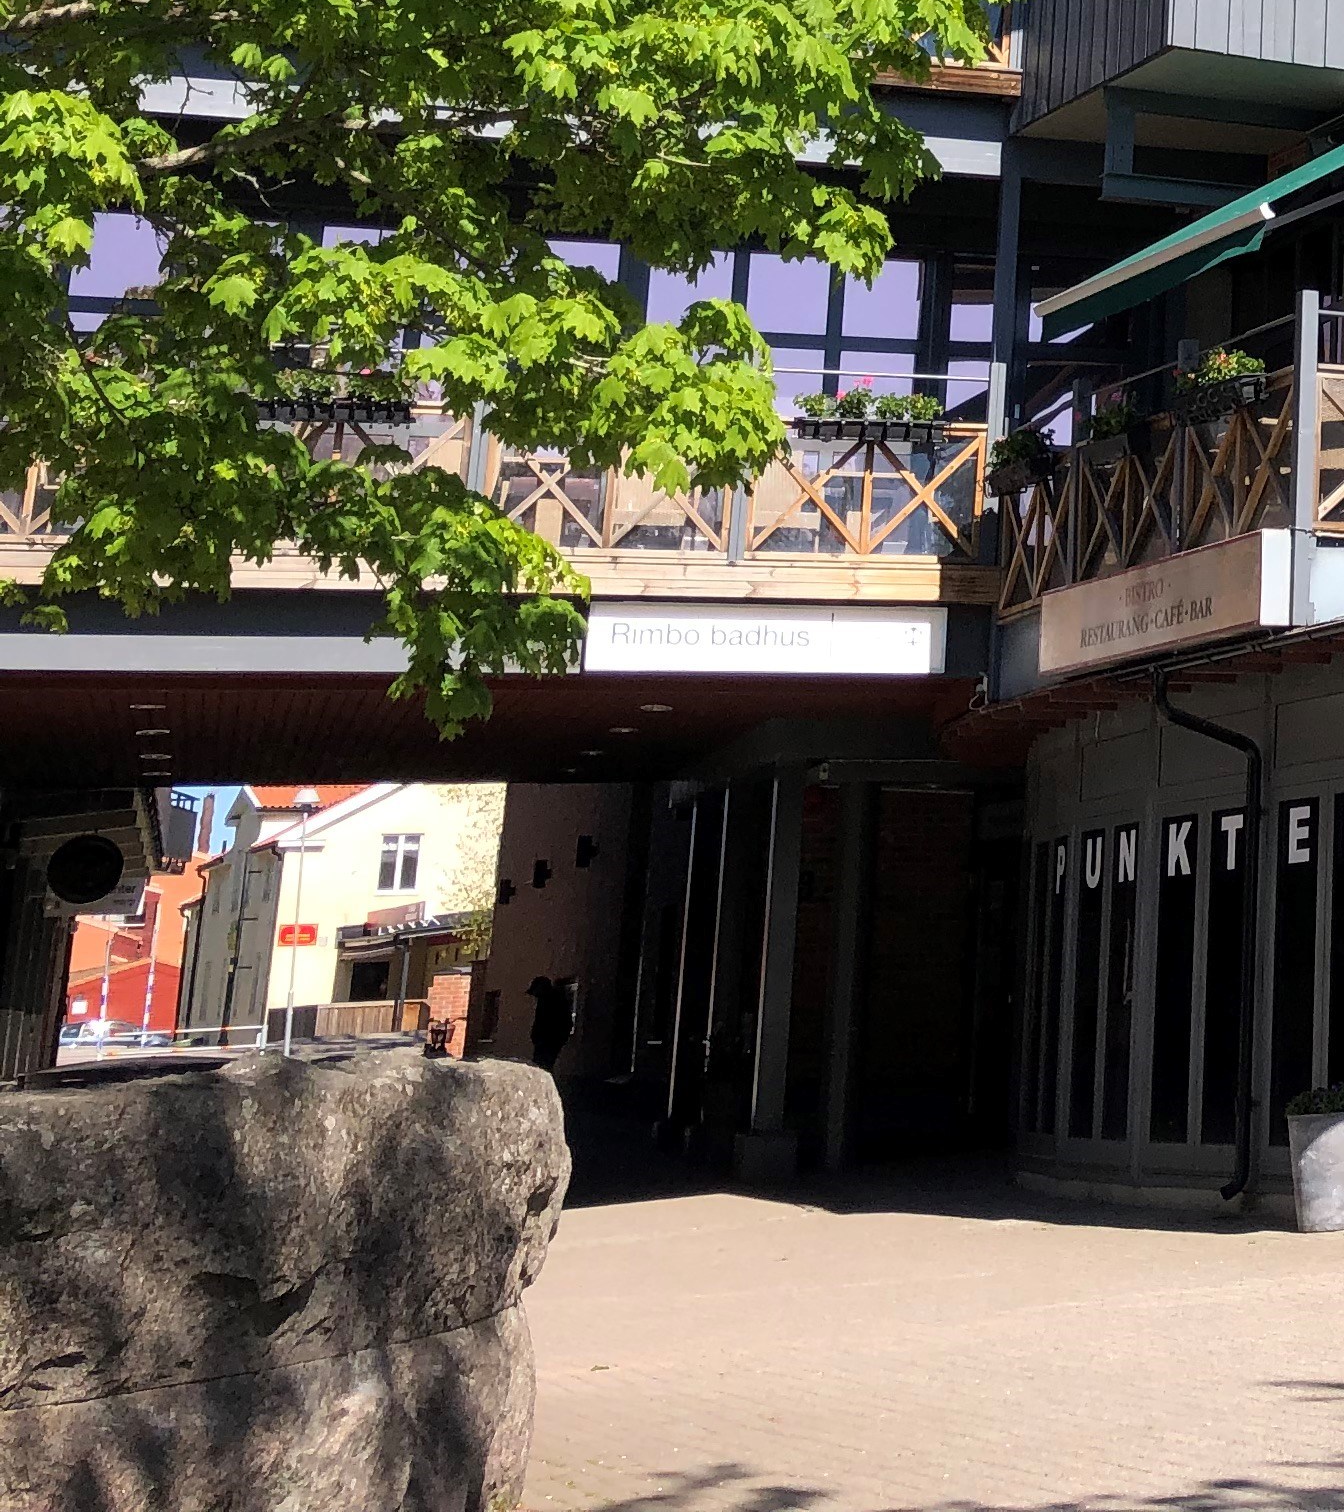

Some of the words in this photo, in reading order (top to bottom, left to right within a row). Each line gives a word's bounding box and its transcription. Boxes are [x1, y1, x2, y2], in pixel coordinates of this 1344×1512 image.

[1124, 577, 1165, 607] BISTRO
[610, 622, 700, 646] Rimbo
[711, 624, 810, 647] badhus
[1079, 611, 1149, 648] RESTAURANG
[1189, 596, 1213, 623] BAR
